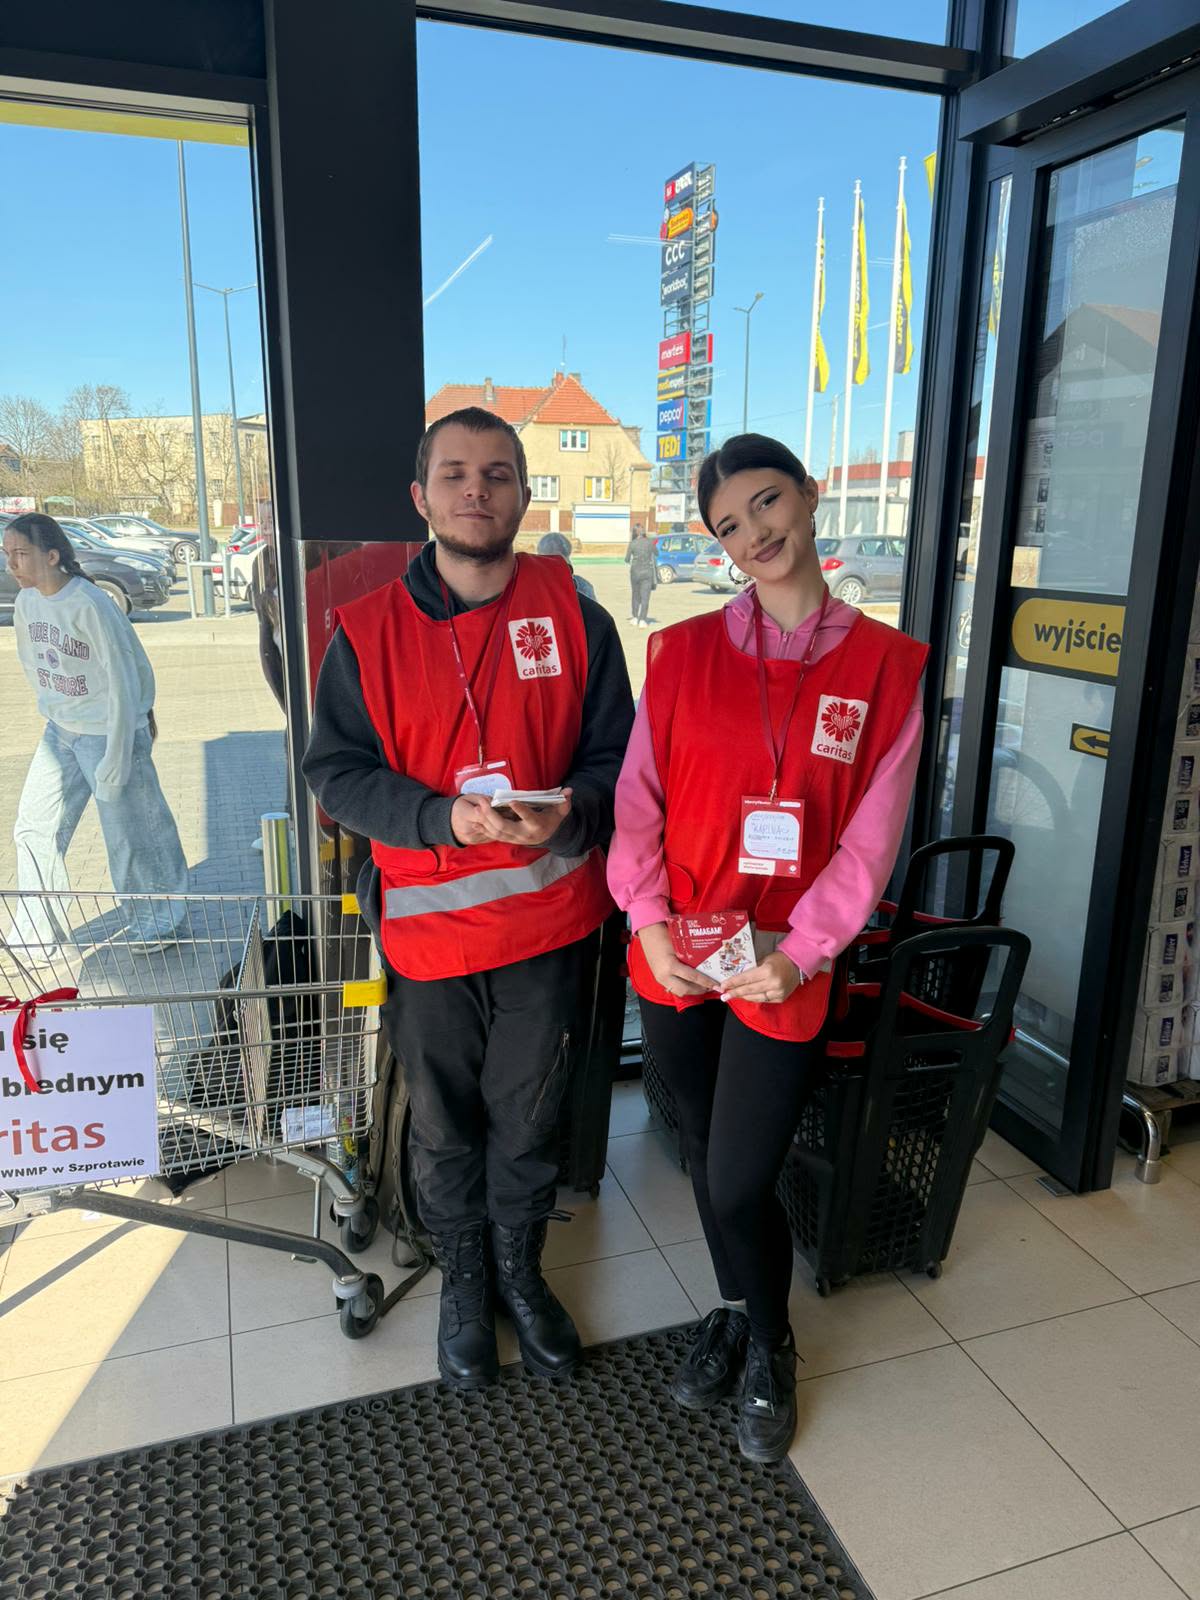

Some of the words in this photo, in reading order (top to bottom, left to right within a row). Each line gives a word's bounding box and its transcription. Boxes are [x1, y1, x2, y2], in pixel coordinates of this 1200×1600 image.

[665, 240, 686, 267] CCC
[659, 407, 682, 426] pepco
[1033, 618, 1122, 654] wyjście
[522, 663, 558, 677] caritas
[816, 742, 853, 760] caritas
[22, 1028, 69, 1053] się
[1, 1166, 47, 1178] WNMP
[68, 1158, 145, 1172] Szprotawie
